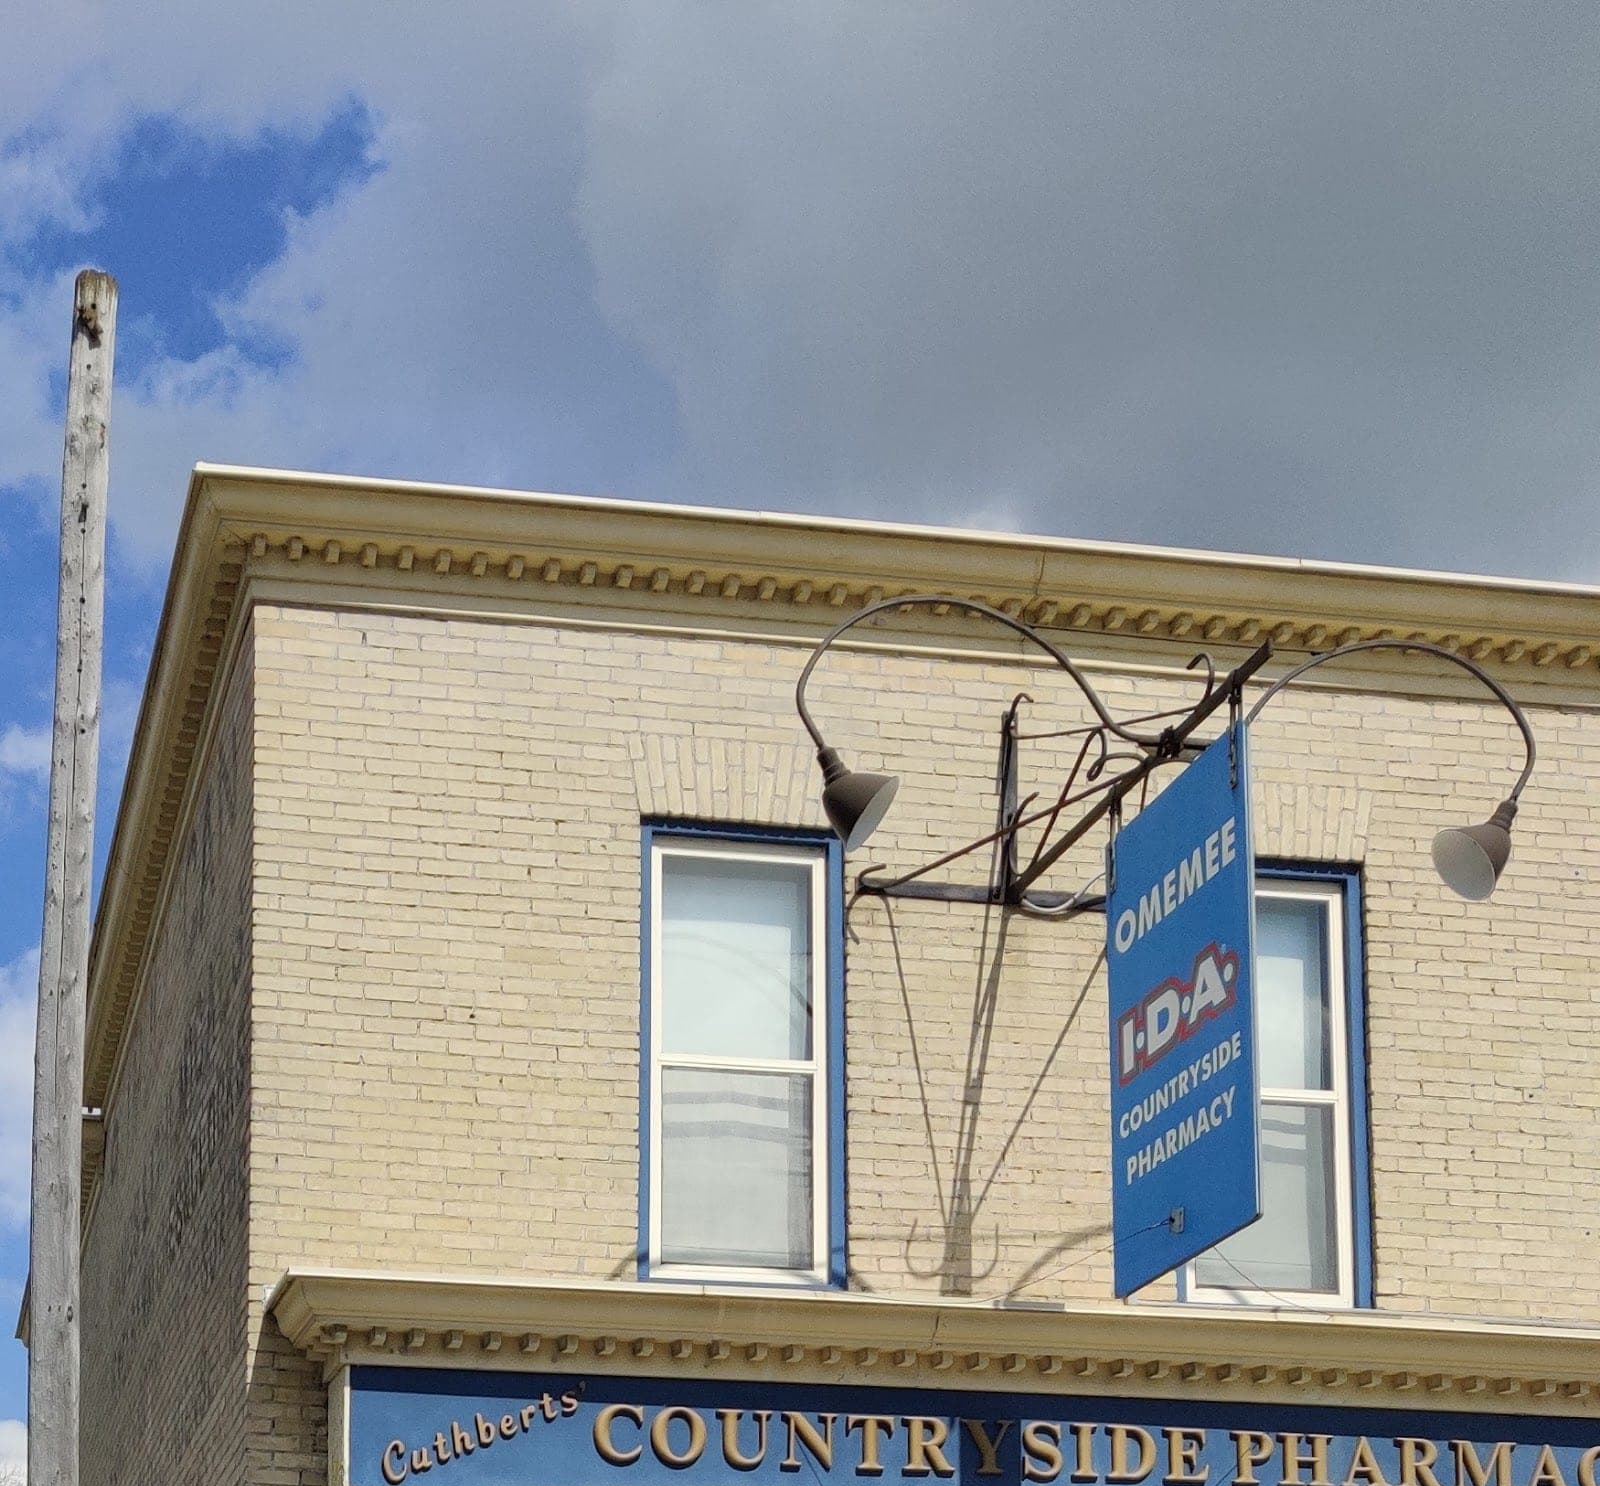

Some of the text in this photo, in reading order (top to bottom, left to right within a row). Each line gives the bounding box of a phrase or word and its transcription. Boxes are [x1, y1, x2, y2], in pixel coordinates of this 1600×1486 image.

[1115, 816, 1237, 954] OMEMEE
[1119, 1030, 1242, 1139] COUNTRYSIDE
[1126, 1085, 1237, 1185] PHARMACY
[593, 1403, 1210, 1486] COUNTRYSIDE
